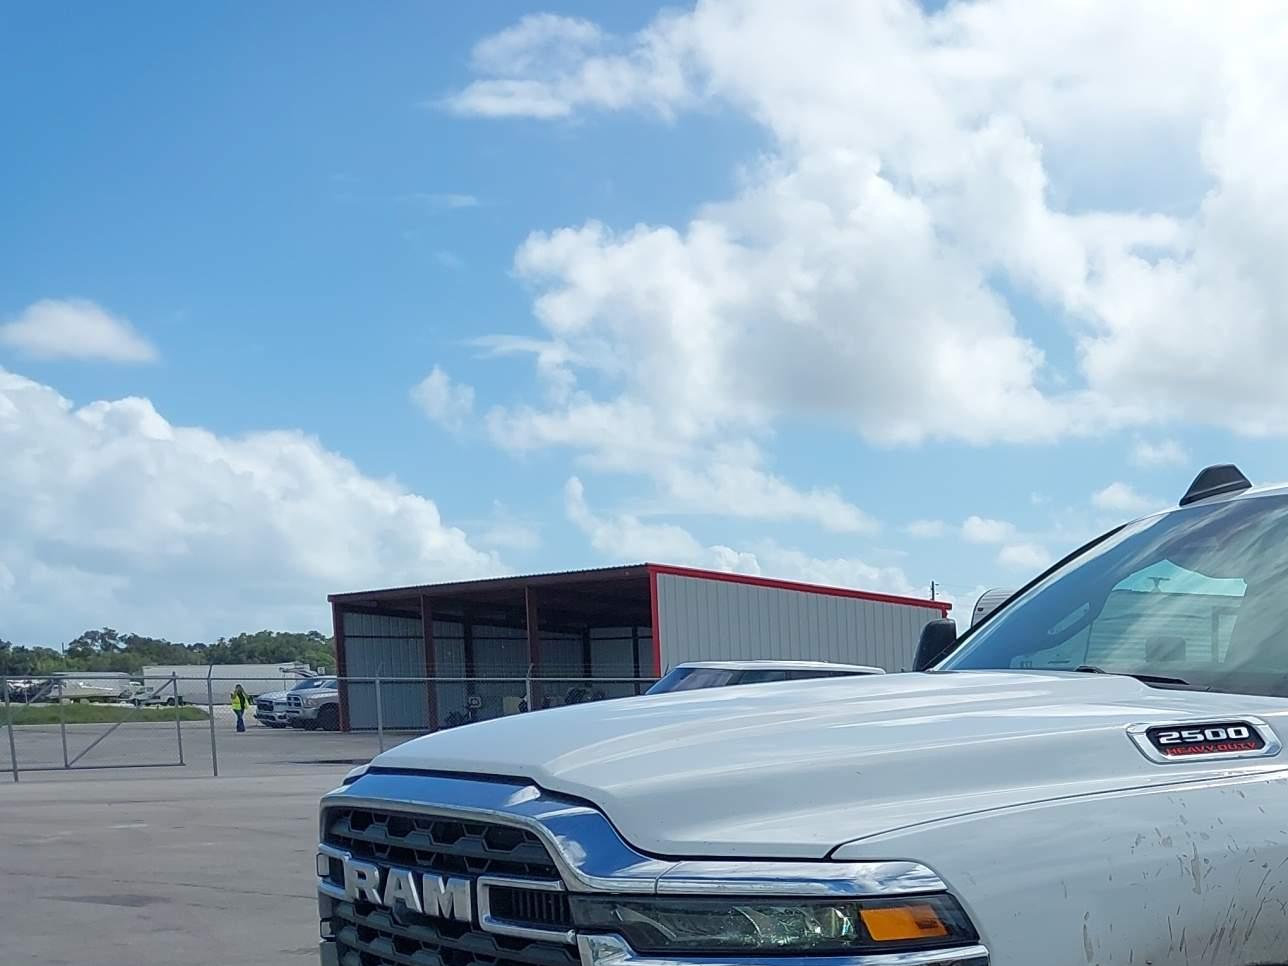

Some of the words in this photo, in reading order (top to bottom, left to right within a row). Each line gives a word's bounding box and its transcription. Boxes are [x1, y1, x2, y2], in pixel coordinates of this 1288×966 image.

[1158, 726, 1250, 744] 2500
[1166, 744, 1214, 755] HEAVY
[345, 858, 474, 923] RAM
